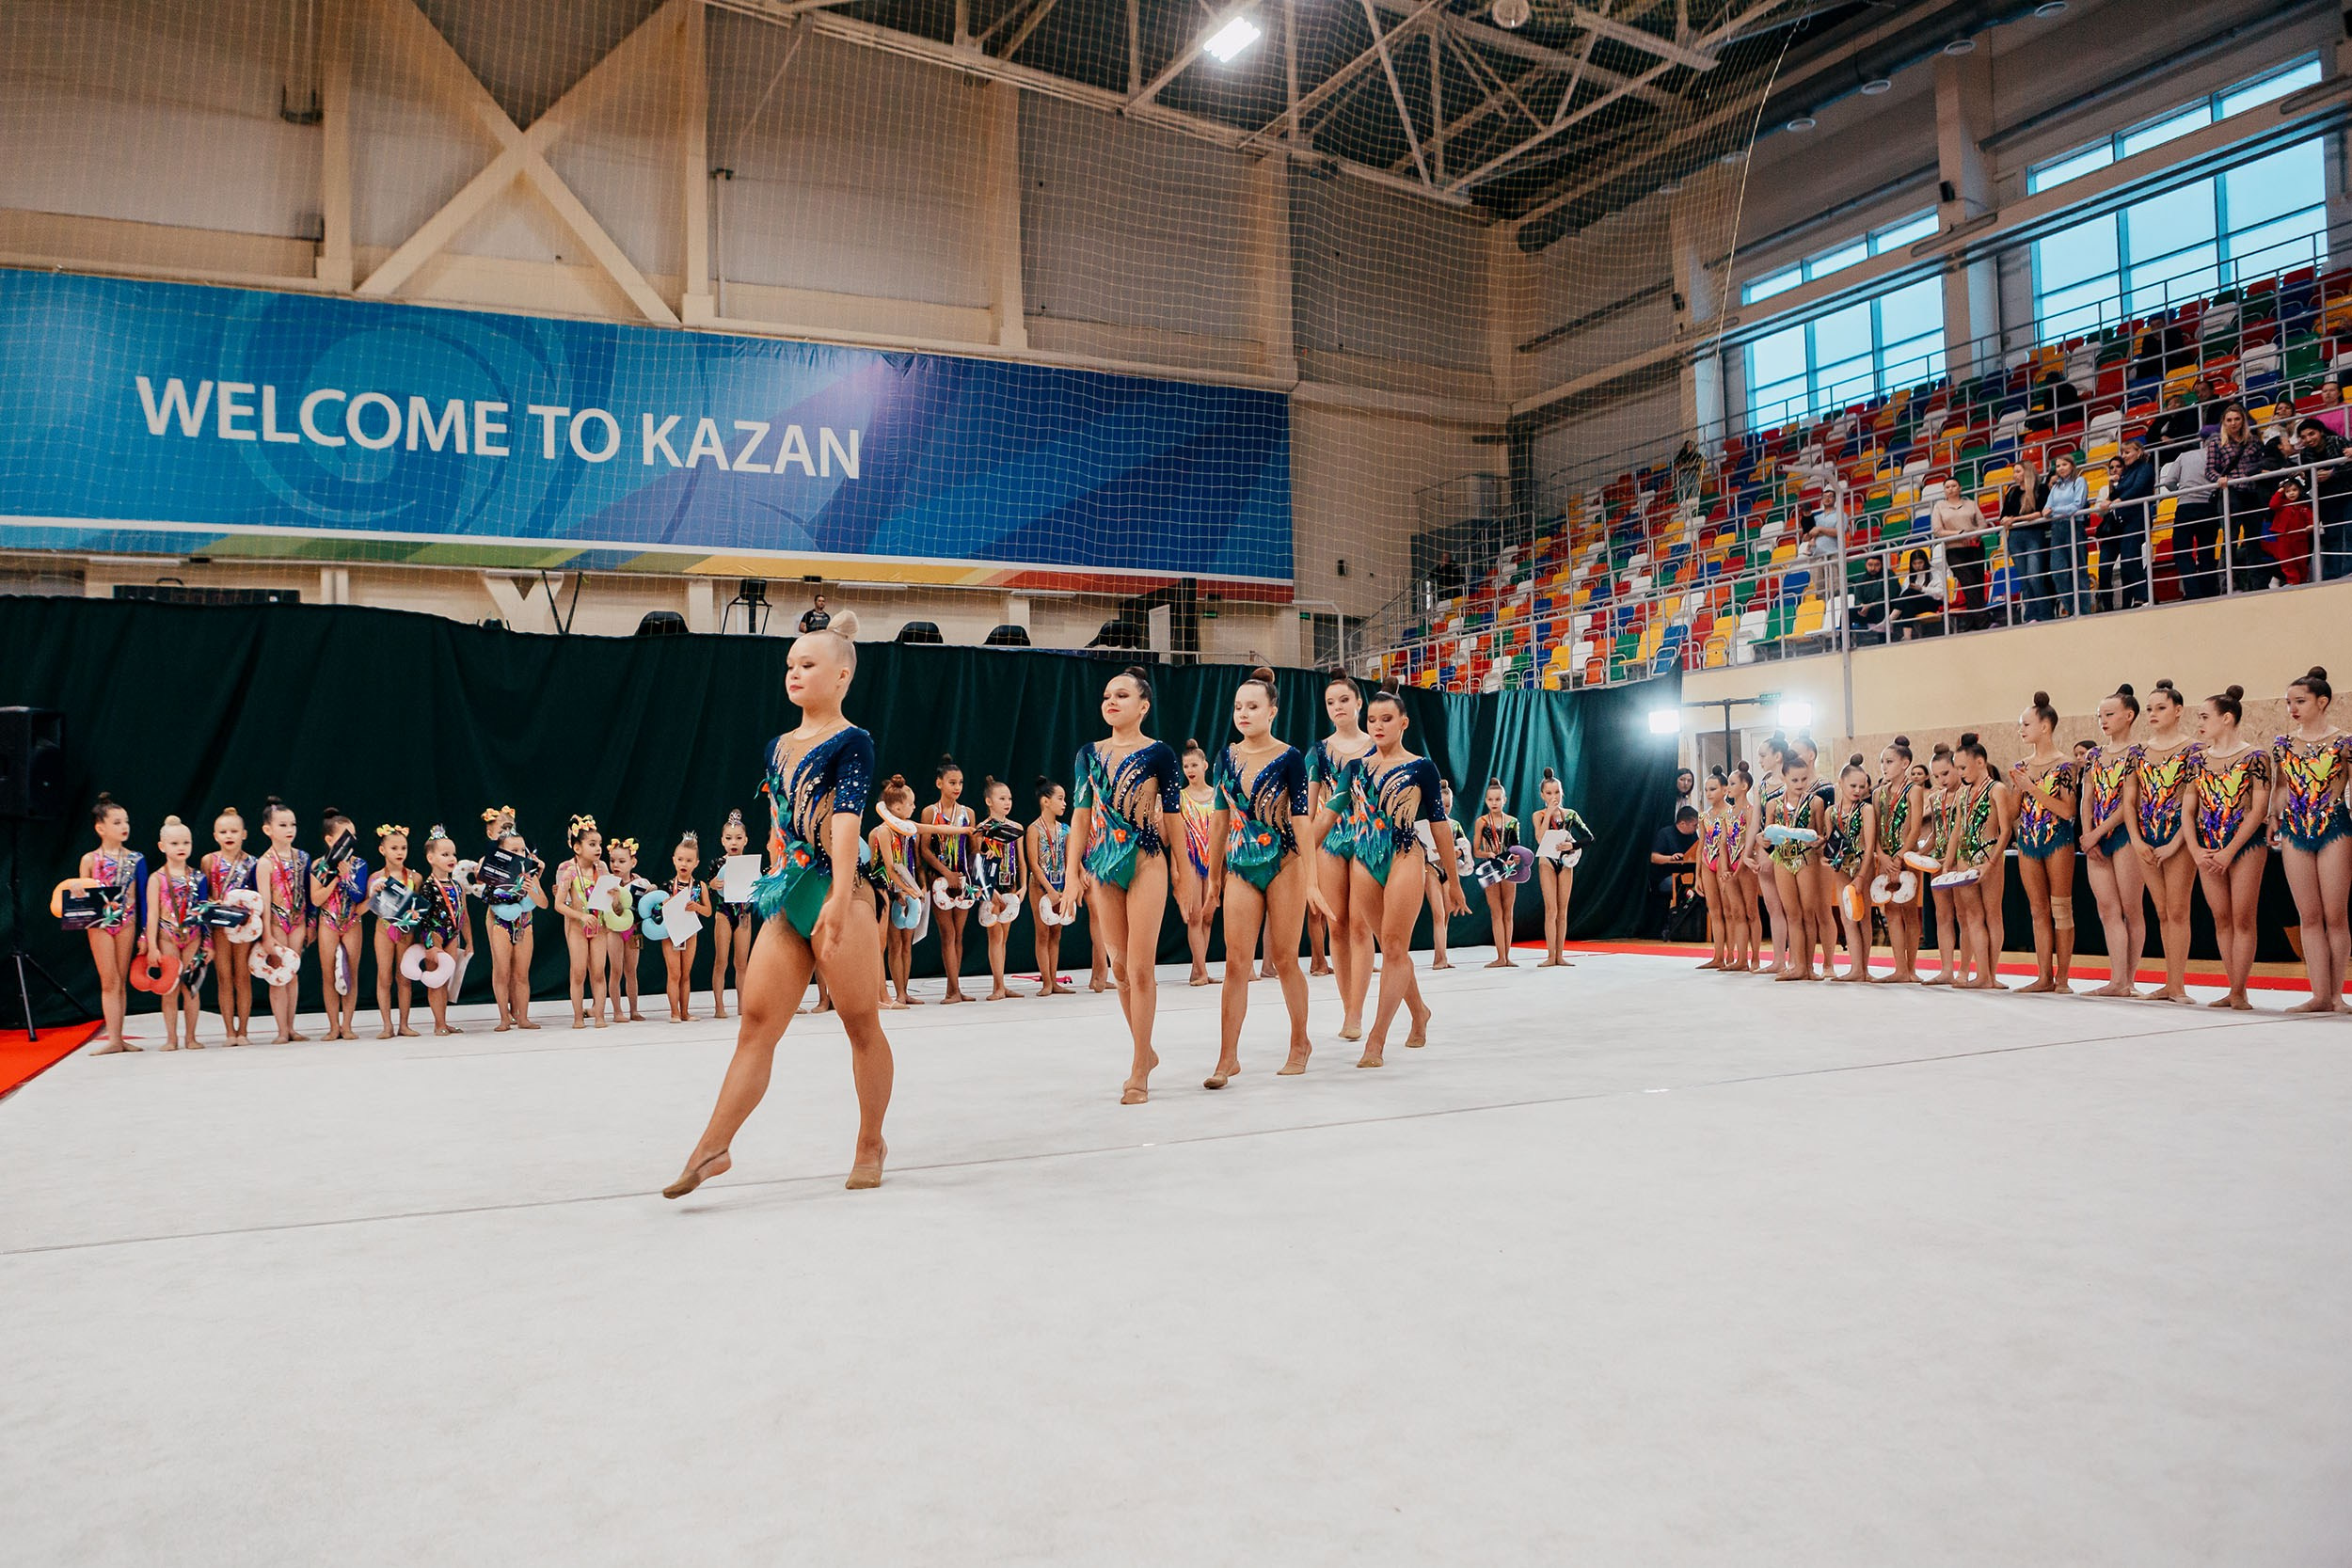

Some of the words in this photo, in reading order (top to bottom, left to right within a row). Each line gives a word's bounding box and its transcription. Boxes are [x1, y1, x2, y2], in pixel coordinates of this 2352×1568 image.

[136, 377, 509, 456] WELCOME
[529, 405, 621, 463] TO
[644, 414, 860, 480] KAZAN
